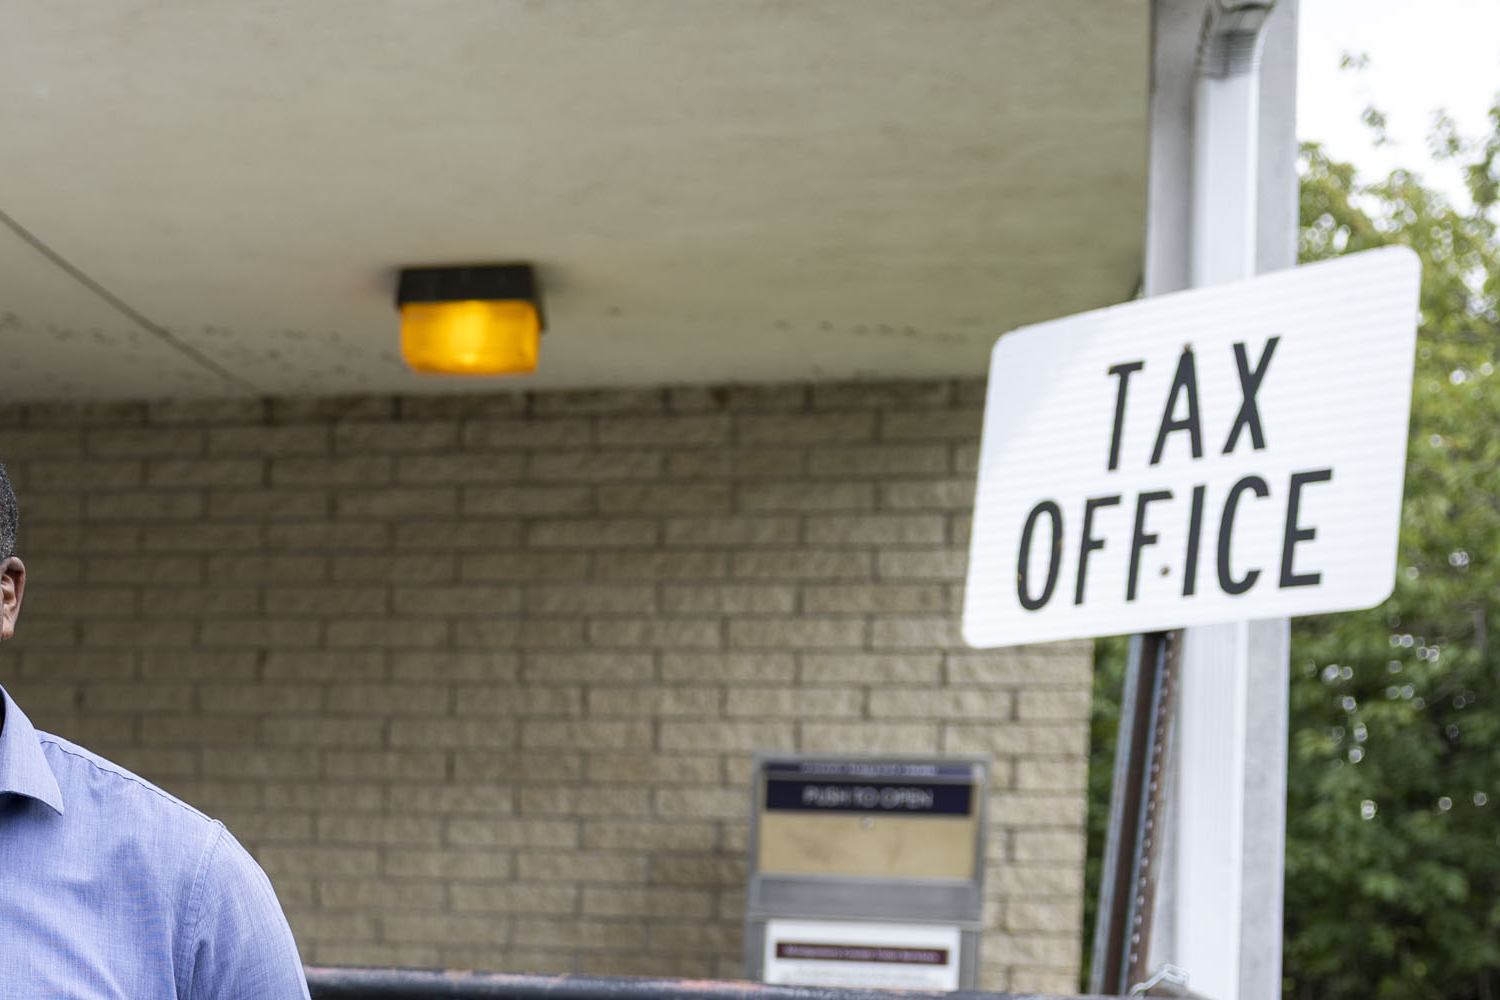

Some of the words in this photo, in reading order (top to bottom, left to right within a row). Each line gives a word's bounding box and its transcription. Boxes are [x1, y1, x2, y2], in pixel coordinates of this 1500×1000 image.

[1107, 334, 1282, 472] TAX
[1016, 468, 1333, 611] OFFICE
[802, 785, 851, 807] PUSH
[854, 786, 879, 808] TO
[879, 787, 934, 809] OPEN
